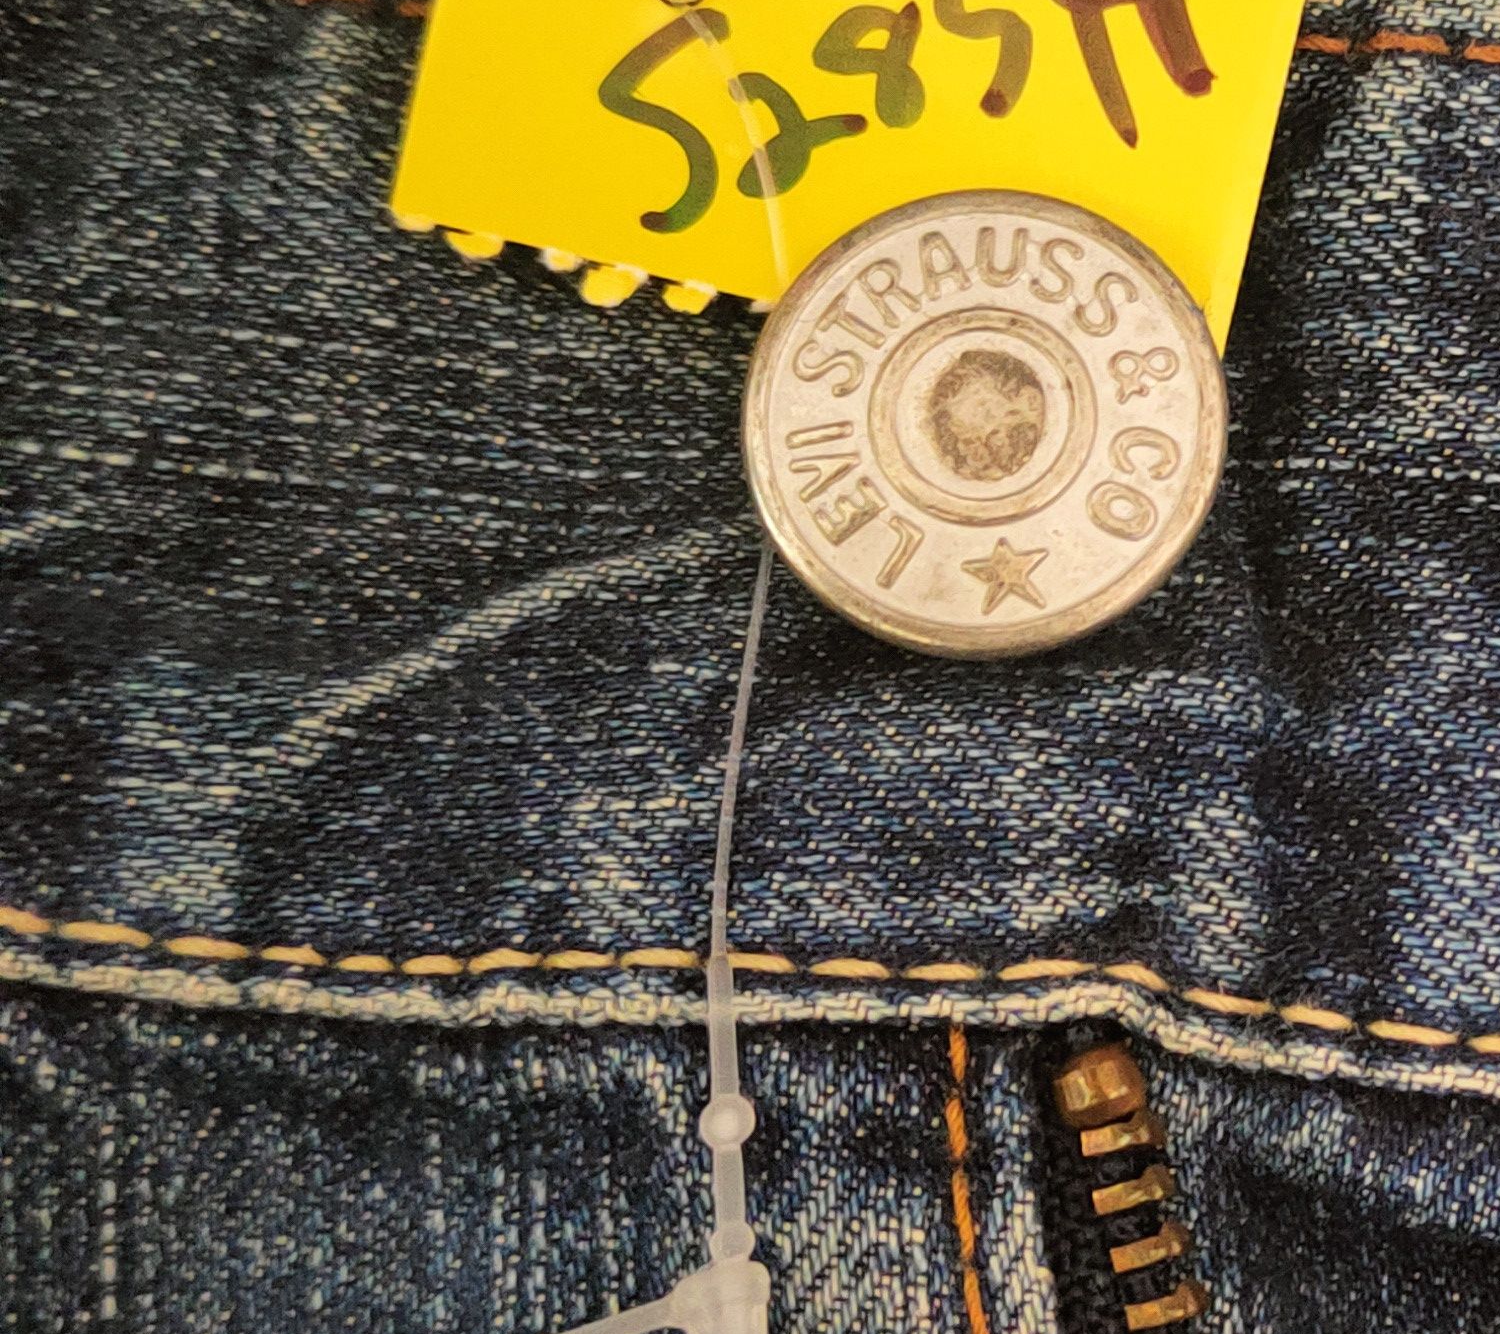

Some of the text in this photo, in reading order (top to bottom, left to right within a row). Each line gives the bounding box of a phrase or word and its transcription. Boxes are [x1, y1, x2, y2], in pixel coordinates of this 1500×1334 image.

[786, 226, 1182, 590] LEVI STRAUSS & CO
